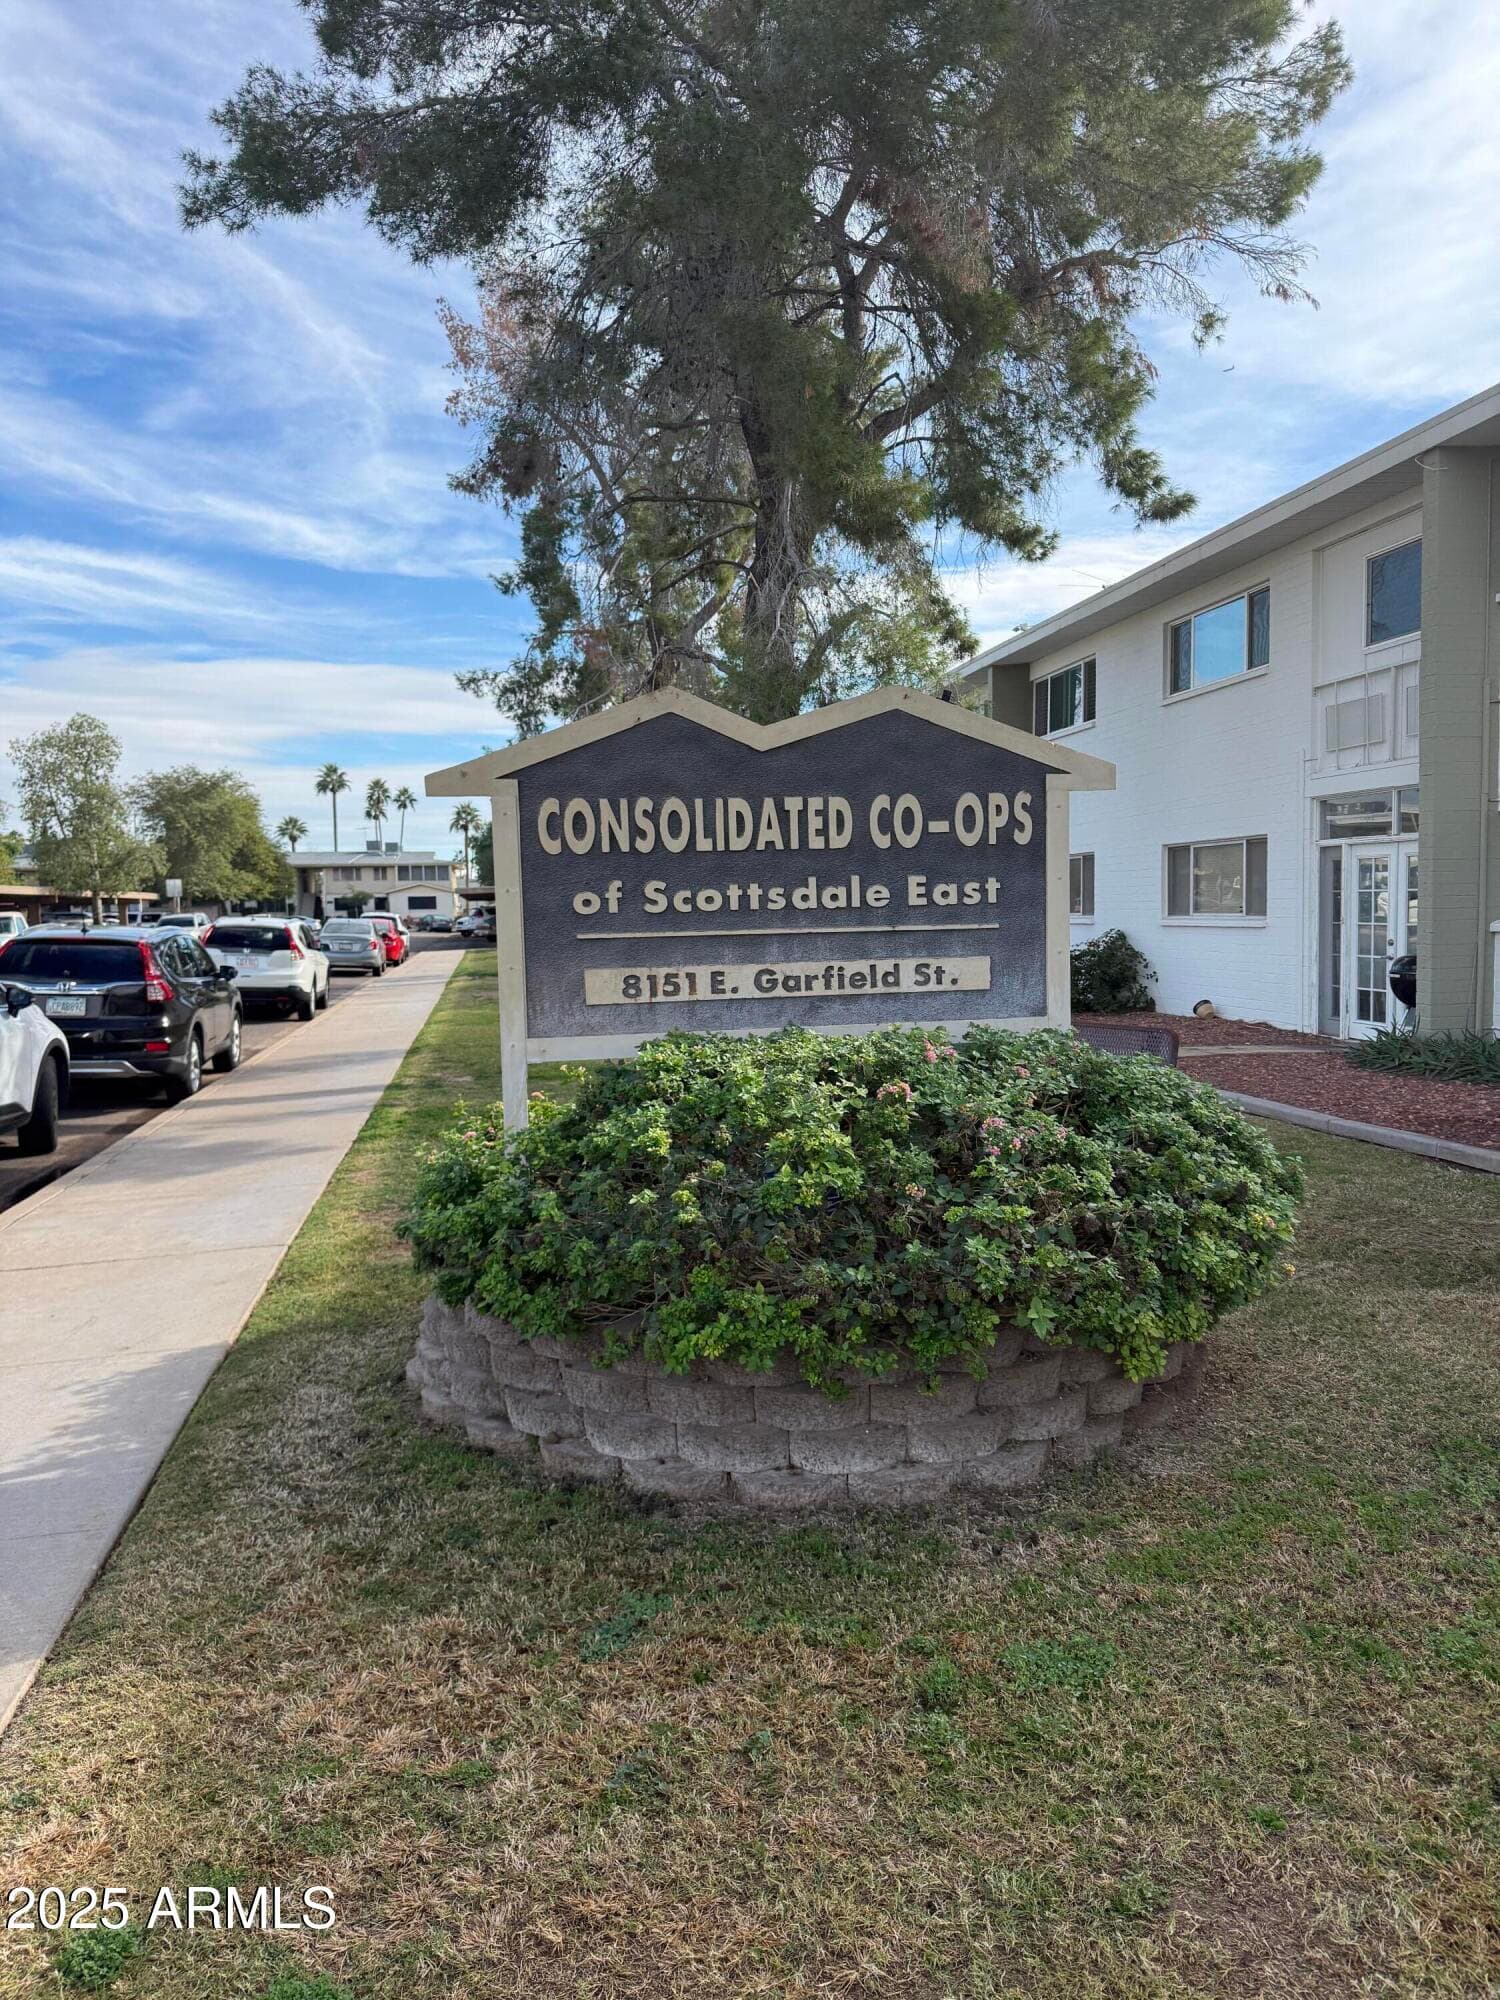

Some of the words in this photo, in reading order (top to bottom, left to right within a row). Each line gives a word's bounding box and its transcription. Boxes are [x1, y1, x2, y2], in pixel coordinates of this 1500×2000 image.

[537, 796, 853, 855] CONSOLIDATED
[869, 791, 1033, 849] CO-OPS
[573, 880, 623, 915] of
[643, 875, 891, 914] Scottsdale
[907, 875, 1001, 906] East
[622, 971, 698, 999] 8151
[710, 970, 739, 995] E.
[753, 963, 900, 994] Garfield
[913, 962, 959, 987] St.
